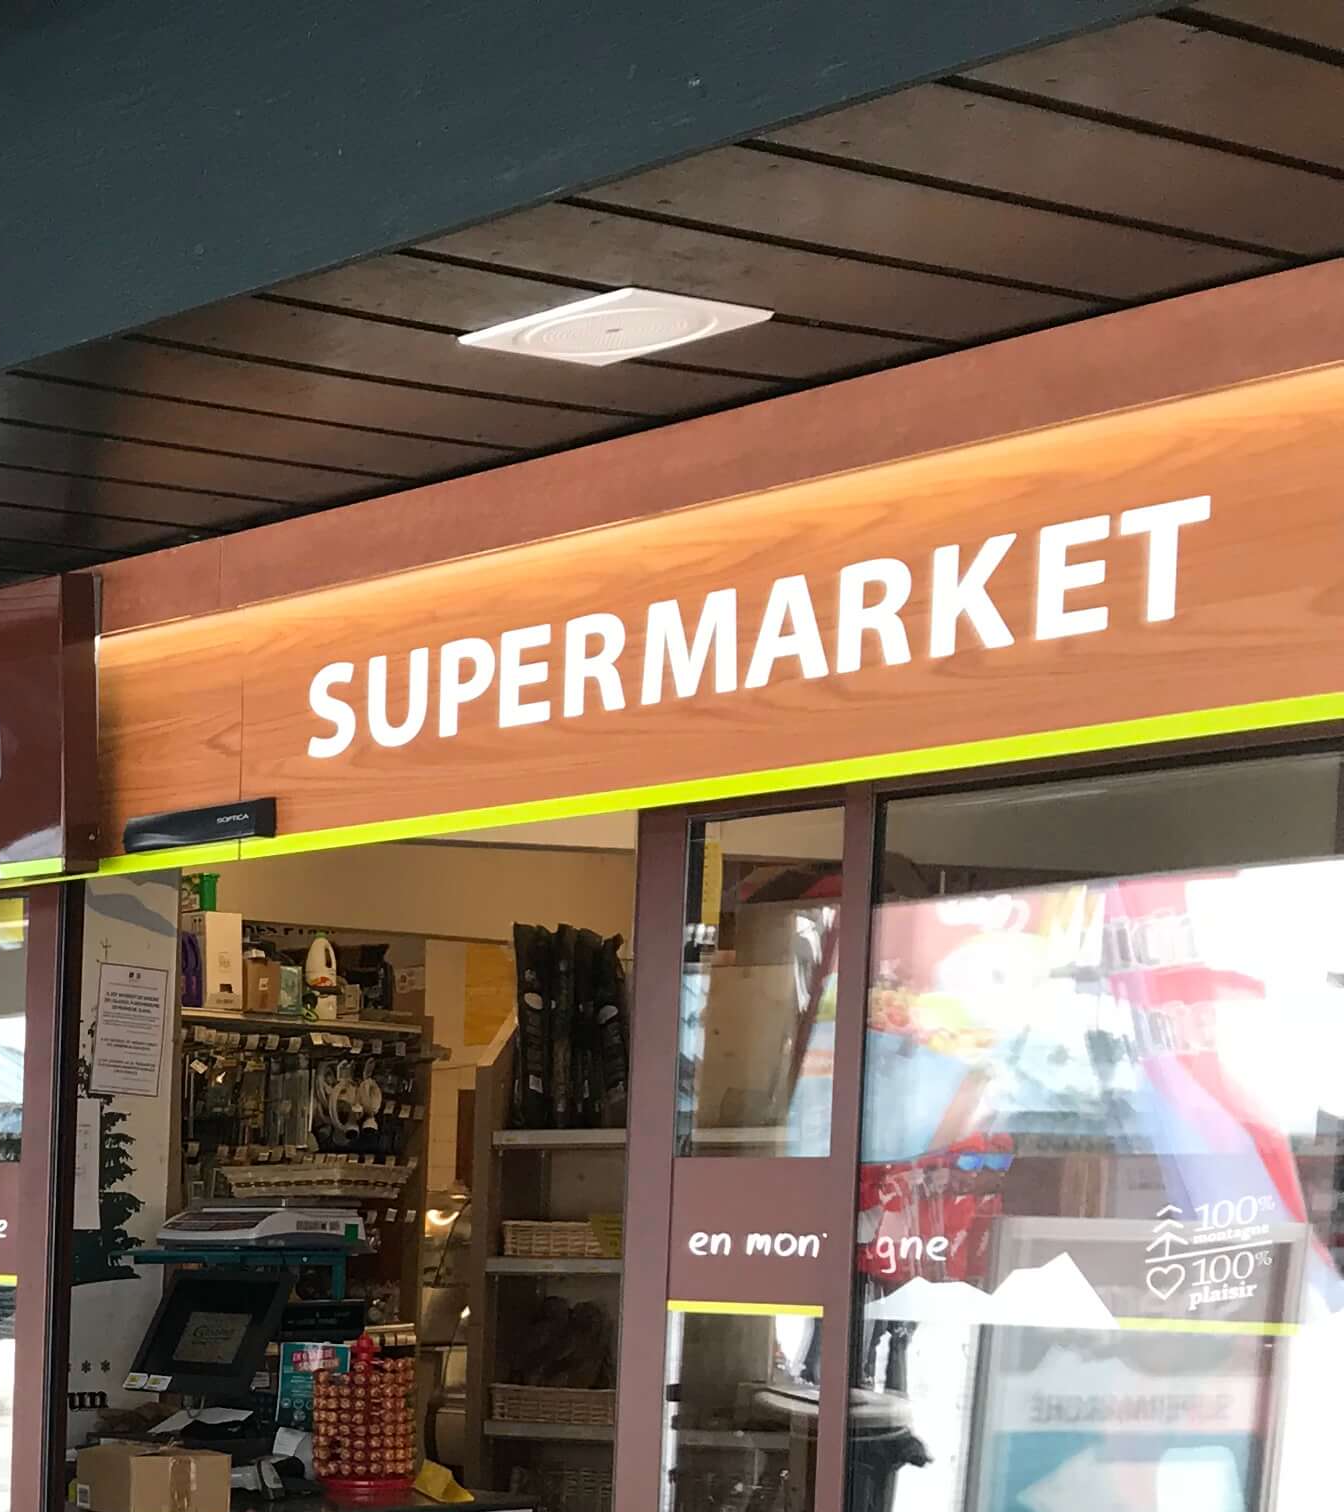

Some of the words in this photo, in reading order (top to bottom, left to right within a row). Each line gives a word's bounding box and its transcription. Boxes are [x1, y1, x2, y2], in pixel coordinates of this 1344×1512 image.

[306, 494, 1211, 758] SUPERMARKET
[1194, 1195, 1275, 1232] 100%
[688, 1232, 731, 1256] en
[1192, 1224, 1269, 1244] montagne
[1192, 1250, 1273, 1286] 100%
[1188, 1281, 1257, 1311] plaisir
